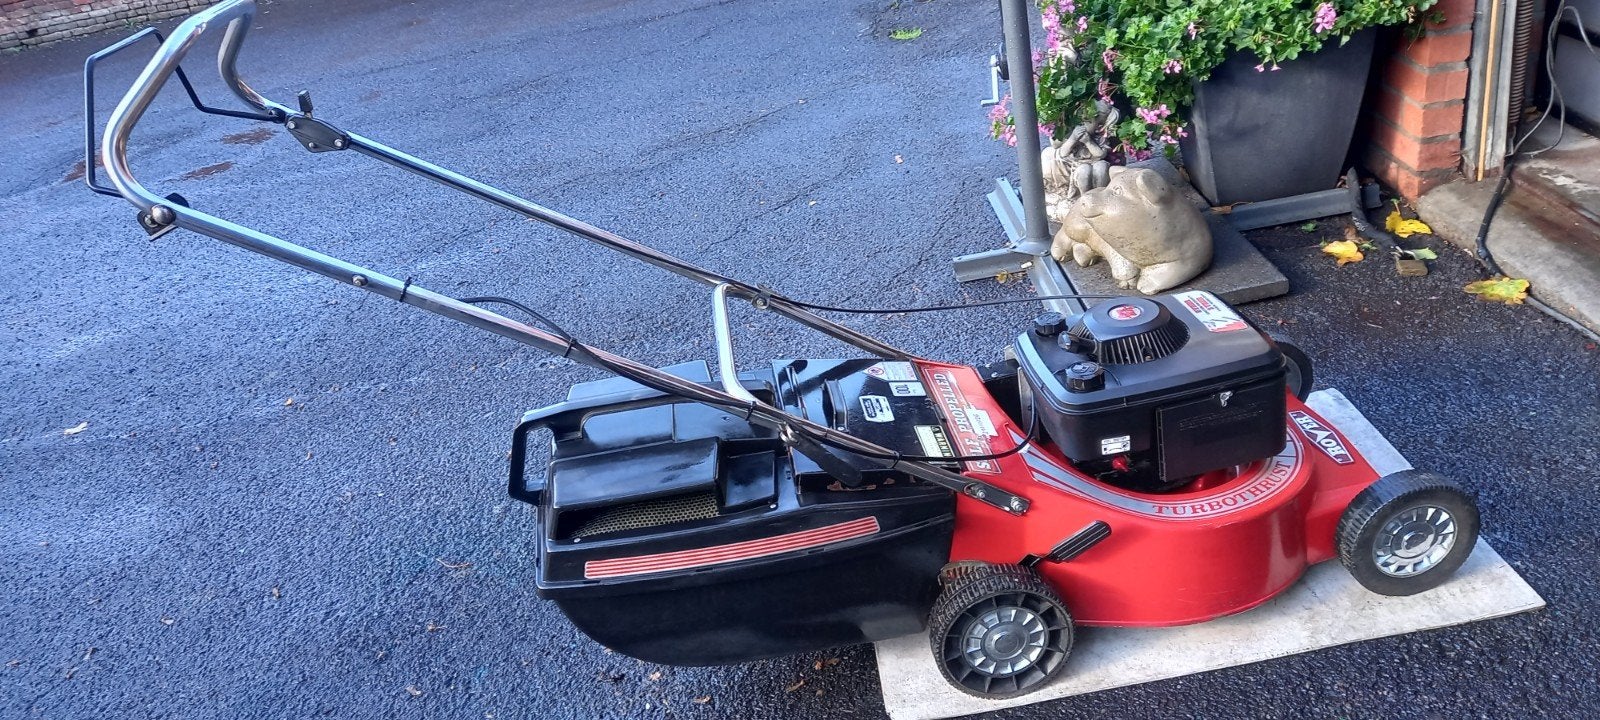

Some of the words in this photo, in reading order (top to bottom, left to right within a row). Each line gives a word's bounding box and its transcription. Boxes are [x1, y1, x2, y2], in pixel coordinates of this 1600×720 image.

[933, 373, 975, 434] PROPELLED
[934, 431, 953, 459] WARNIN
[966, 438, 990, 470] SLF
[1298, 416, 1344, 457] ROVER
[1152, 460, 1291, 516] TURBOTHRUST
